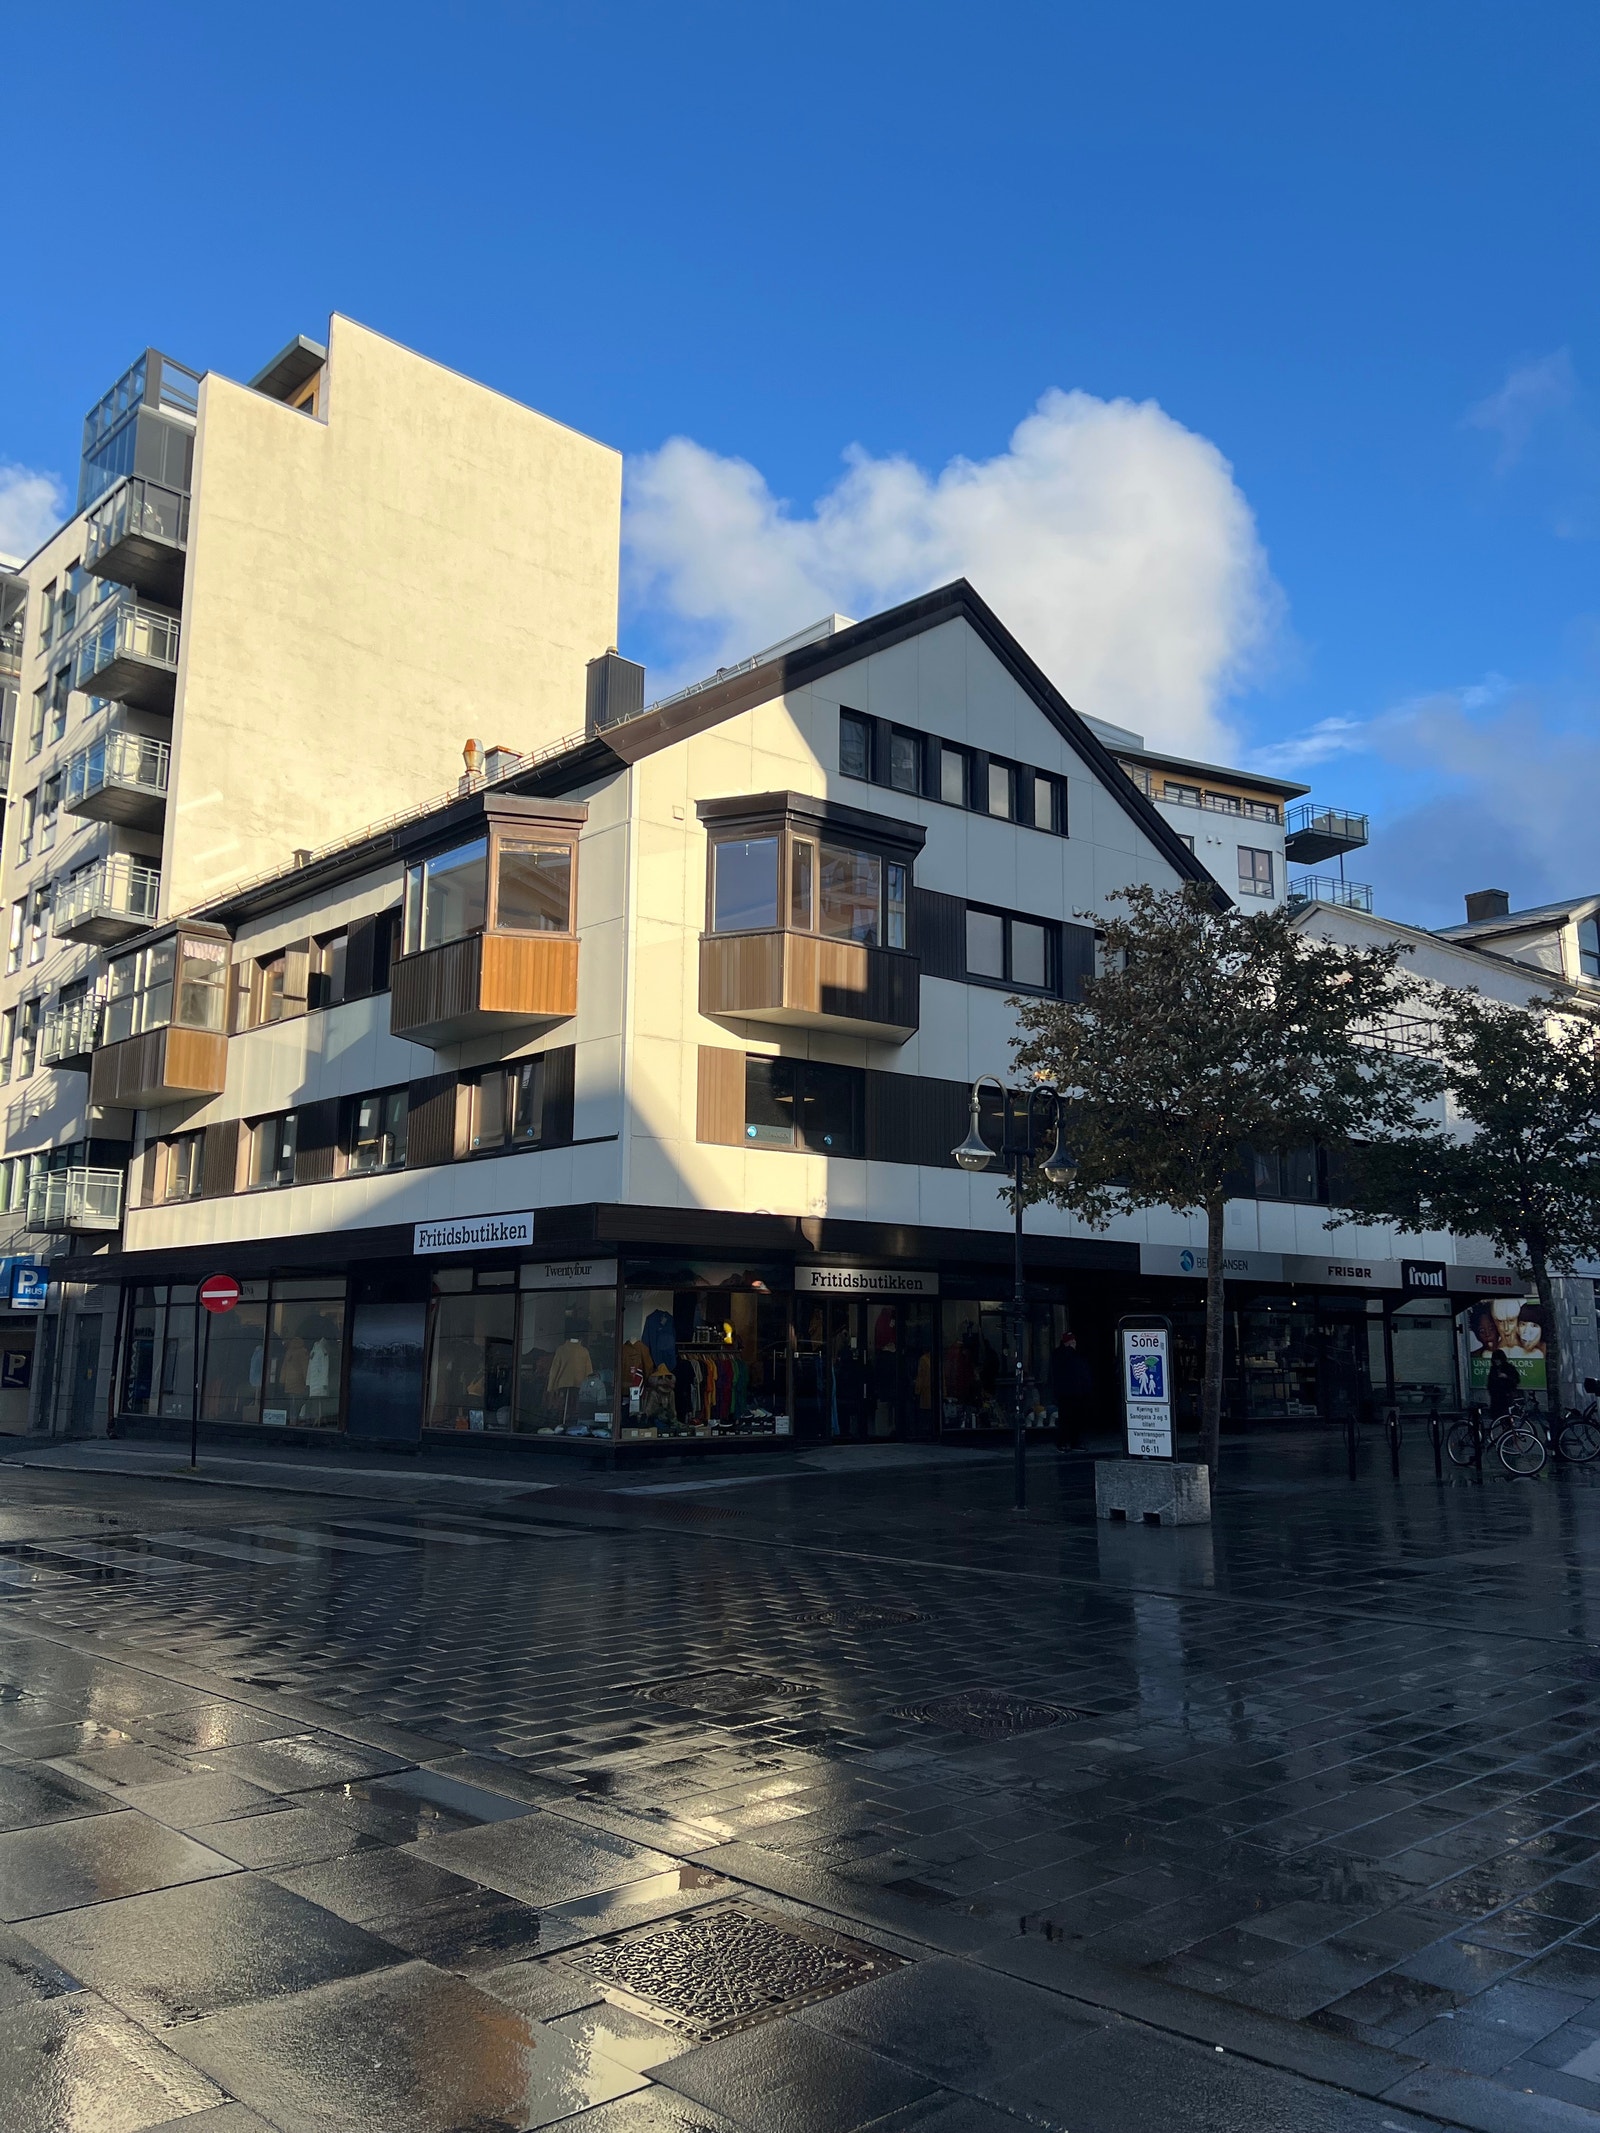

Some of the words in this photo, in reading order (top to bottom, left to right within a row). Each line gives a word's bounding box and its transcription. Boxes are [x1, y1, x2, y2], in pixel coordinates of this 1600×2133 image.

[418, 1222, 527, 1248] Fritidsbutikken
[544, 1262, 592, 1279] Twentyfour
[1196, 1257, 1248, 1271] BEANSEN
[1327, 1265, 1372, 1279] FRISØR
[1408, 1266, 1444, 1287] front
[17, 1269, 39, 1294] P
[810, 1272, 924, 1290] Fritidsbutikken
[1475, 1274, 1512, 1286] FRISØR
[25, 1287, 43, 1295] HUS
[1131, 1334, 1159, 1348] Sone
[1136, 1406, 1153, 1414] Kjøring
